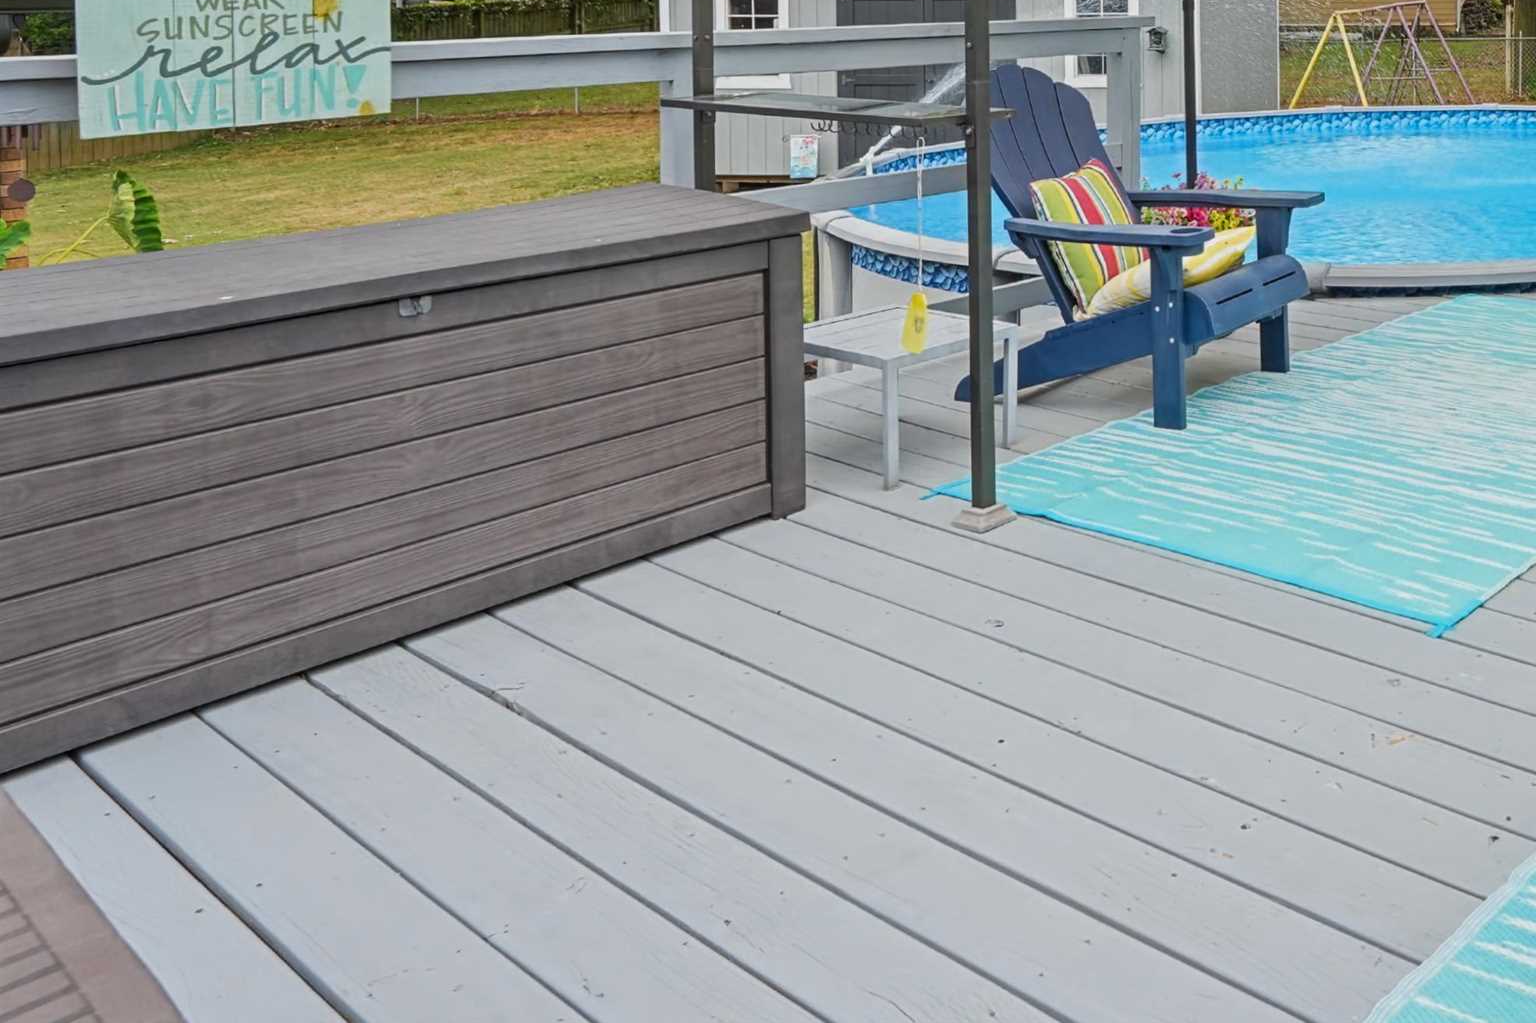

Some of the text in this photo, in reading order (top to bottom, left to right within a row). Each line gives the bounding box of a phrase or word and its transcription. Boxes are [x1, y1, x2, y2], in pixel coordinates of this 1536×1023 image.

[136, 11, 343, 43] SUNSCREEN
[81, 31, 391, 85] relax
[108, 63, 368, 132] HAVE FUN!
